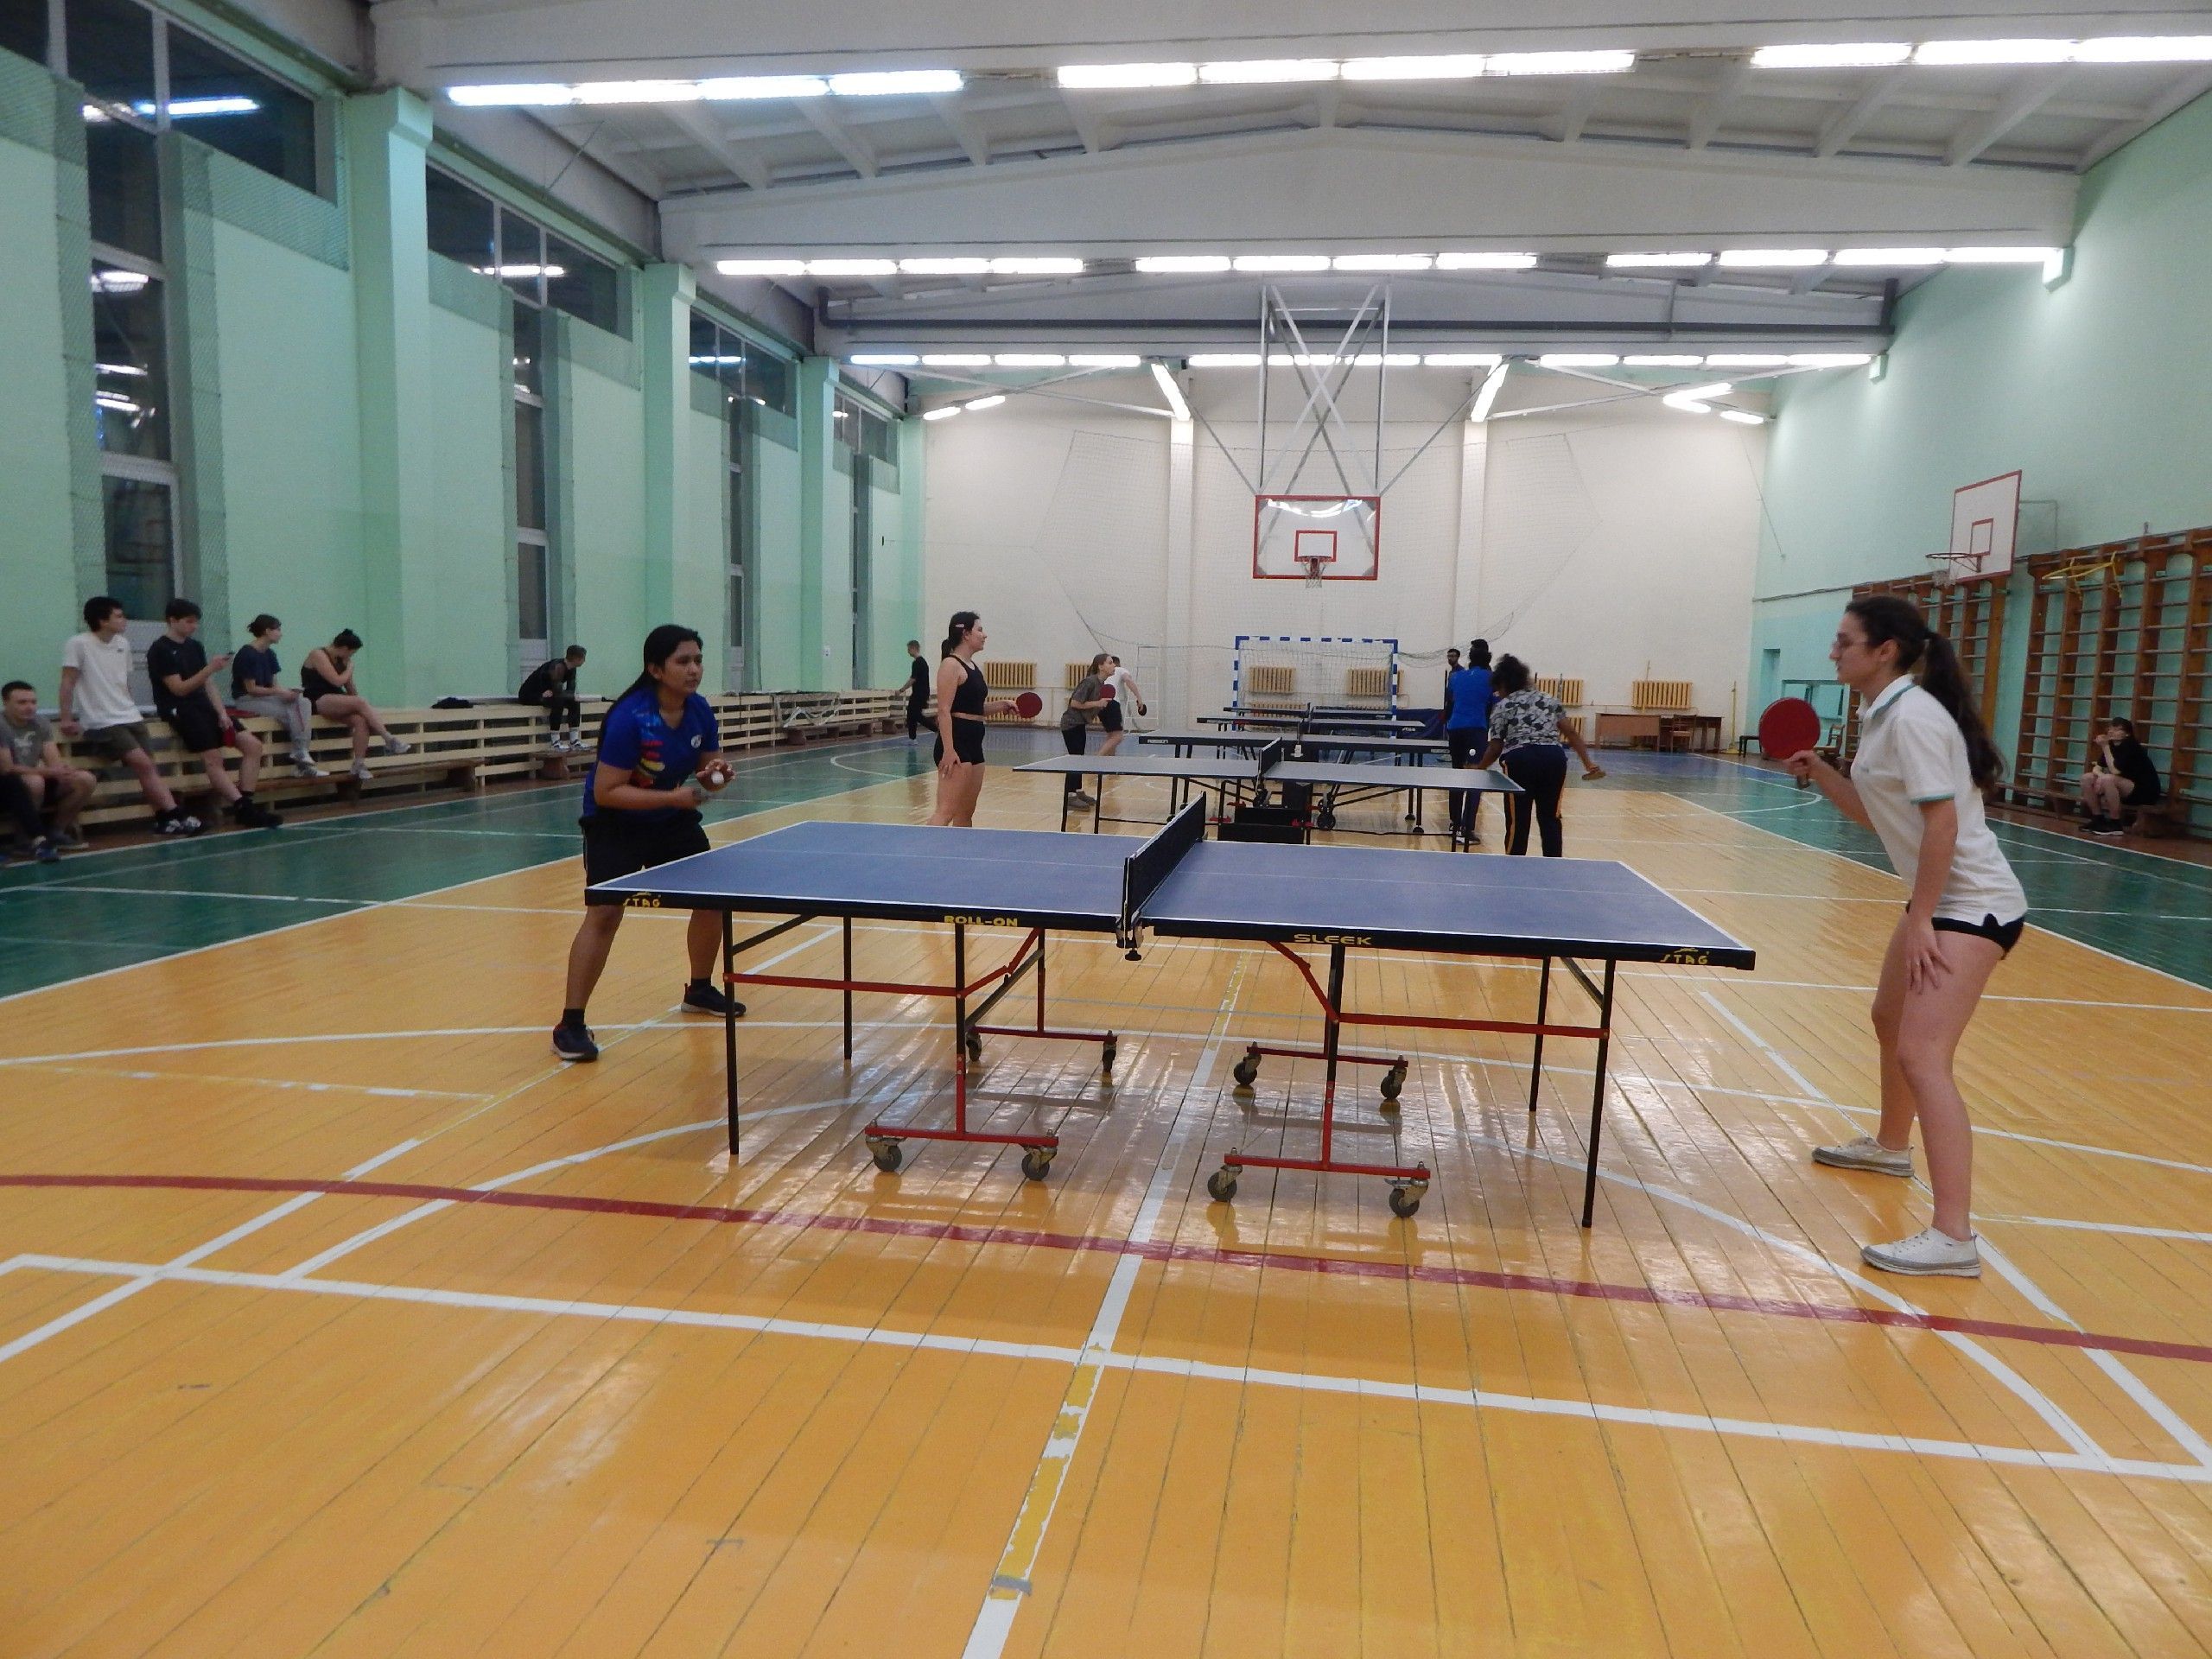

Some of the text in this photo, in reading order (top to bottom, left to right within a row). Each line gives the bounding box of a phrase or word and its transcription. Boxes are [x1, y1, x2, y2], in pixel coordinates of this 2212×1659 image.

[623, 898, 661, 908] STAG
[944, 915, 1018, 927] ROLL-ON
[1294, 933, 1372, 945] SLEEK
[1660, 954, 1708, 965] STAG
